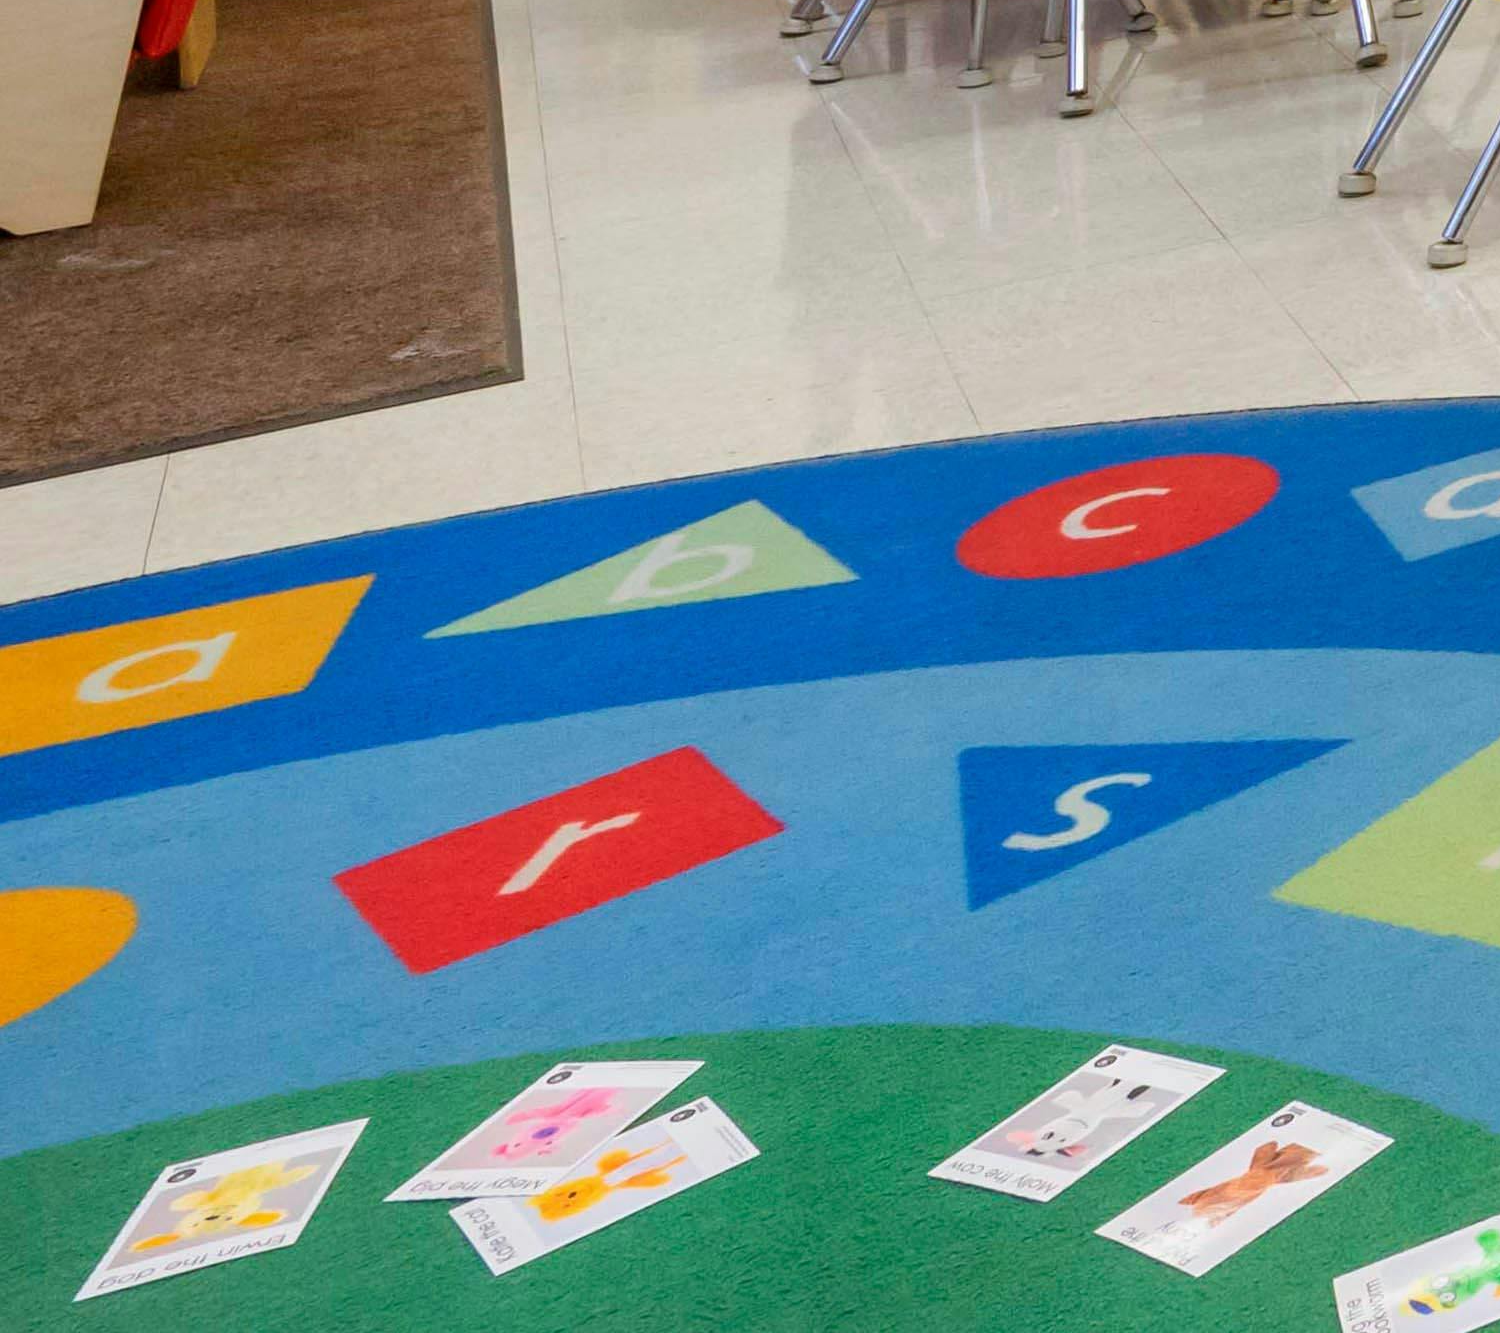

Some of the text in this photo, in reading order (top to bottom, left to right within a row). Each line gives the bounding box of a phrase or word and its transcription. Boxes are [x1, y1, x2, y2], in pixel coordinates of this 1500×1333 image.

[77, 632, 238, 705] a
[606, 530, 754, 606] b
[1059, 487, 1171, 540] c
[496, 811, 643, 897] r
[1001, 772, 1152, 852] s
[408, 1179, 445, 1194] pig
[451, 1179, 482, 1192] the
[949, 1161, 1058, 1195] Molly the cow
[464, 1205, 494, 1224] cat
[478, 1218, 500, 1242] the
[96, 1233, 287, 1292] Erwin the dog
